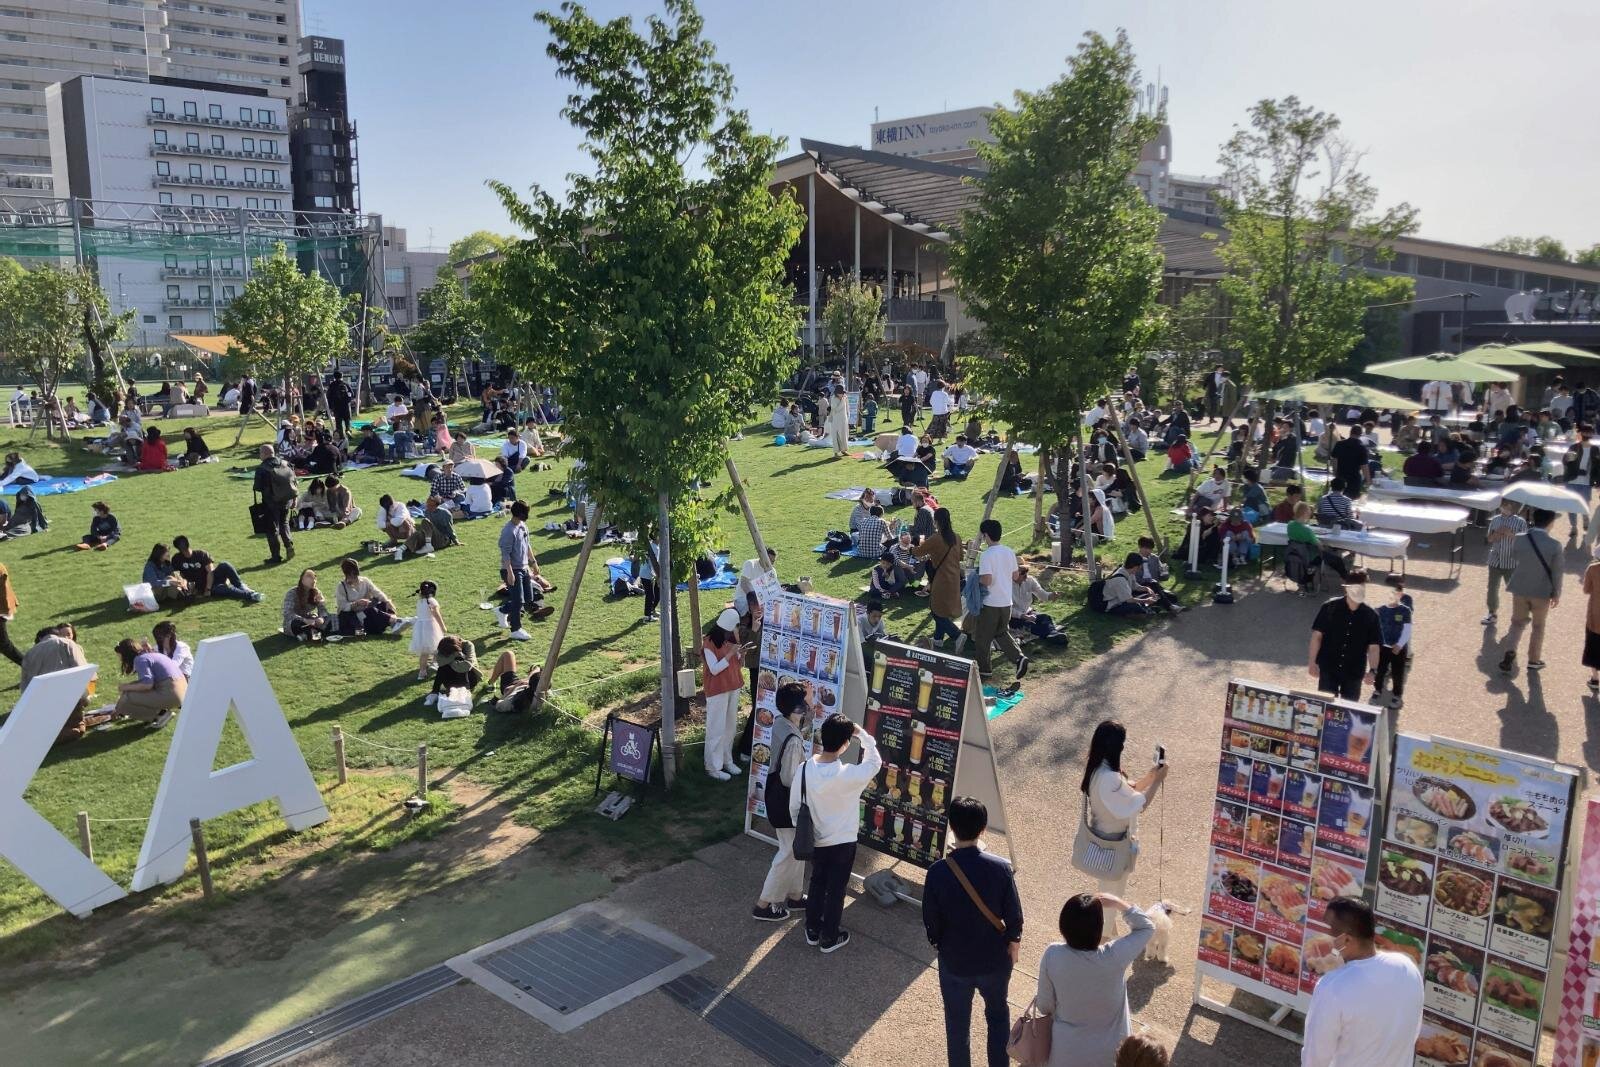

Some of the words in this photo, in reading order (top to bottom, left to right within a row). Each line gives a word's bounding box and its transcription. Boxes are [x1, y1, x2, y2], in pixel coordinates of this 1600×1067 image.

[313, 52, 345, 65] UEMURA
[875, 123, 927, 145] 東横INN
[1527, 800, 1561, 814] ステーキ
[1502, 843, 1555, 863] ローストビーフ
